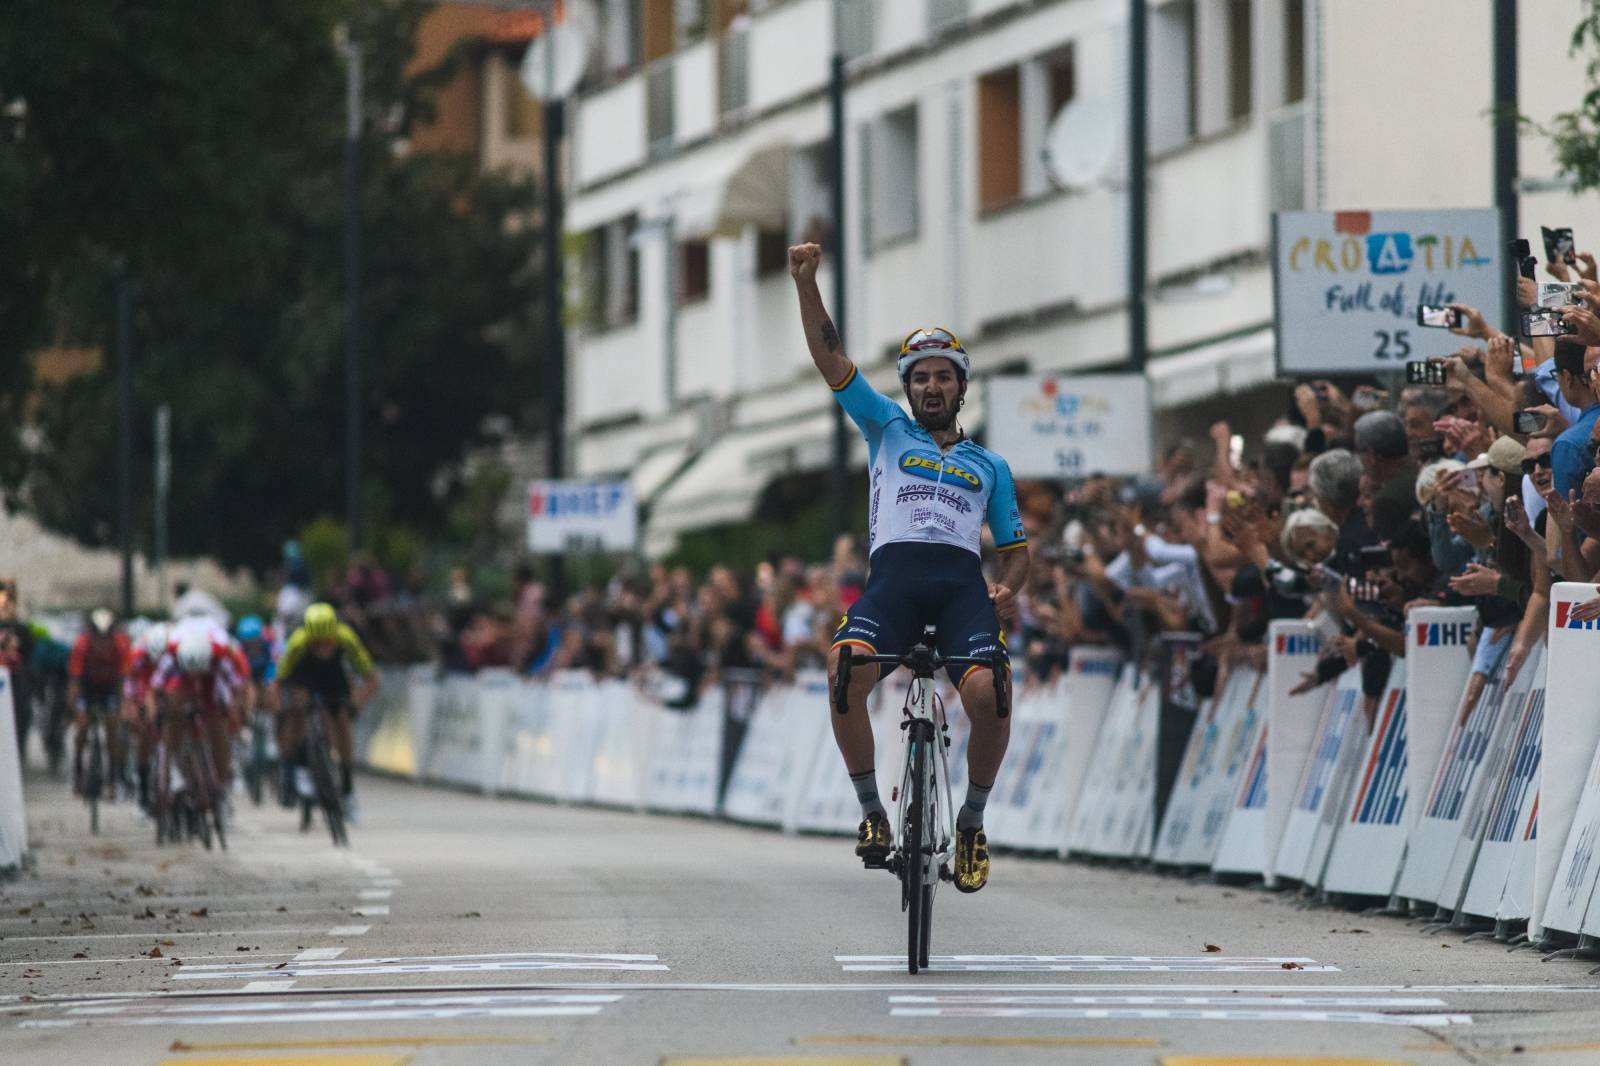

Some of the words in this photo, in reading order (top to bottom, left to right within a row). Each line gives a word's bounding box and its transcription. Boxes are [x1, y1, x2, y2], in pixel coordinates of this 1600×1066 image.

[1288, 234, 1489, 273] CROATIA
[1325, 282, 1374, 313] Full
[1380, 282, 1405, 316] of
[1373, 330, 1411, 359] 25
[903, 456, 981, 487] DELKO
[896, 495, 966, 514] PROVENCE
[897, 484, 965, 505] MARSEILLE
[1442, 623, 1472, 645] HE
